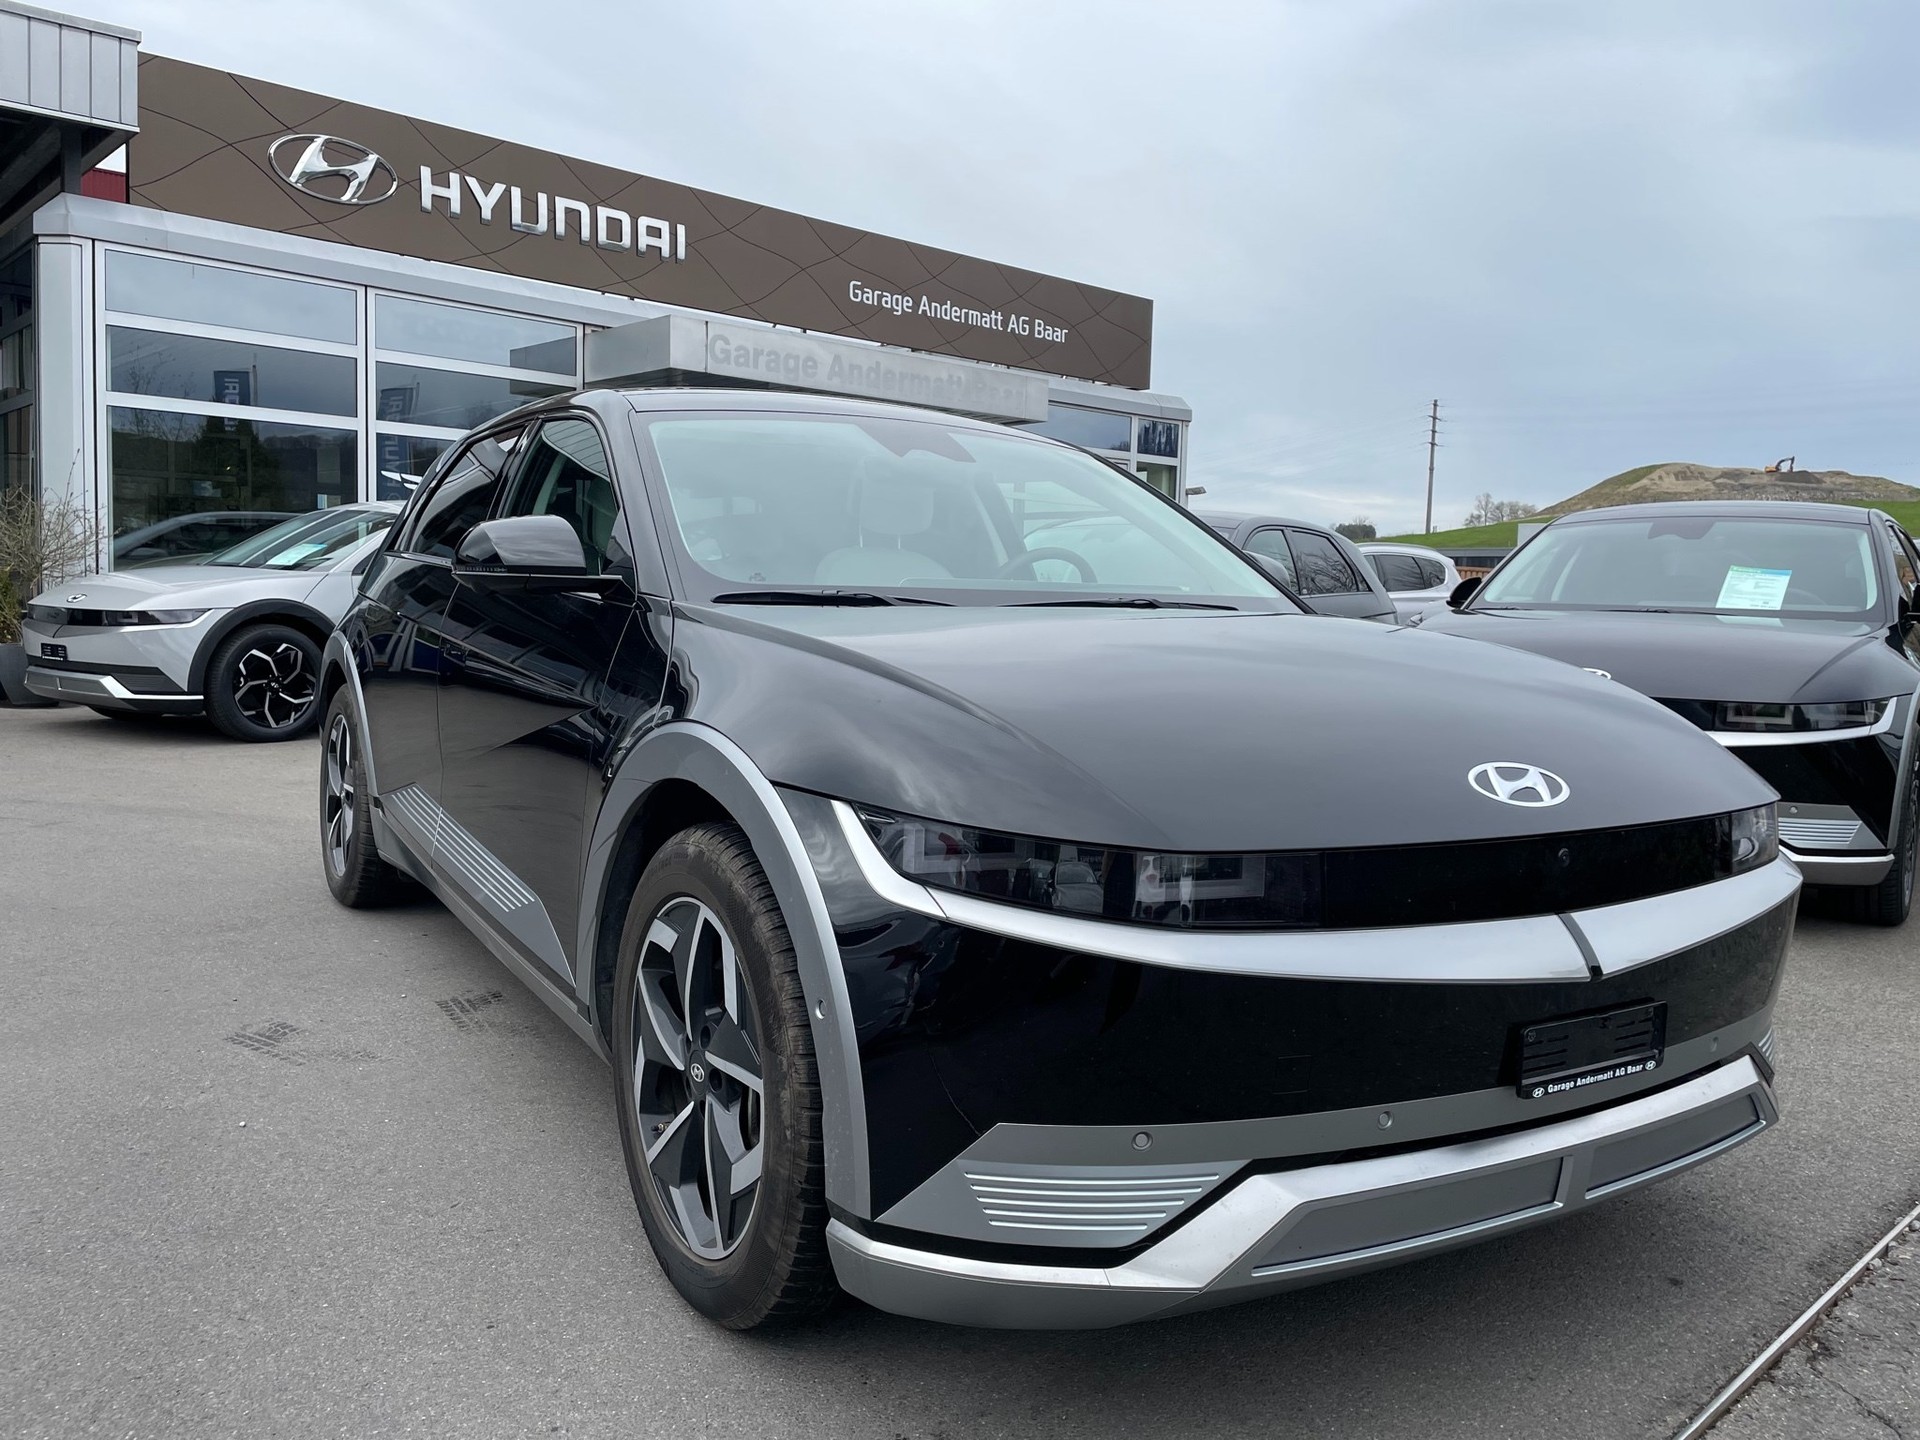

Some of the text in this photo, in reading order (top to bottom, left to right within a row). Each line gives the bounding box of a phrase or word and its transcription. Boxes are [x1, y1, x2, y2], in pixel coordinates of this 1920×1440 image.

[420, 165, 686, 264] HYUNDAI
[849, 280, 1069, 344] Garage Andermatt AG Baar
[708, 333, 819, 382] Garage
[827, 353, 963, 396] Andermatt
[1547, 1064, 1643, 1093] Garage Andermatt AG Baar
